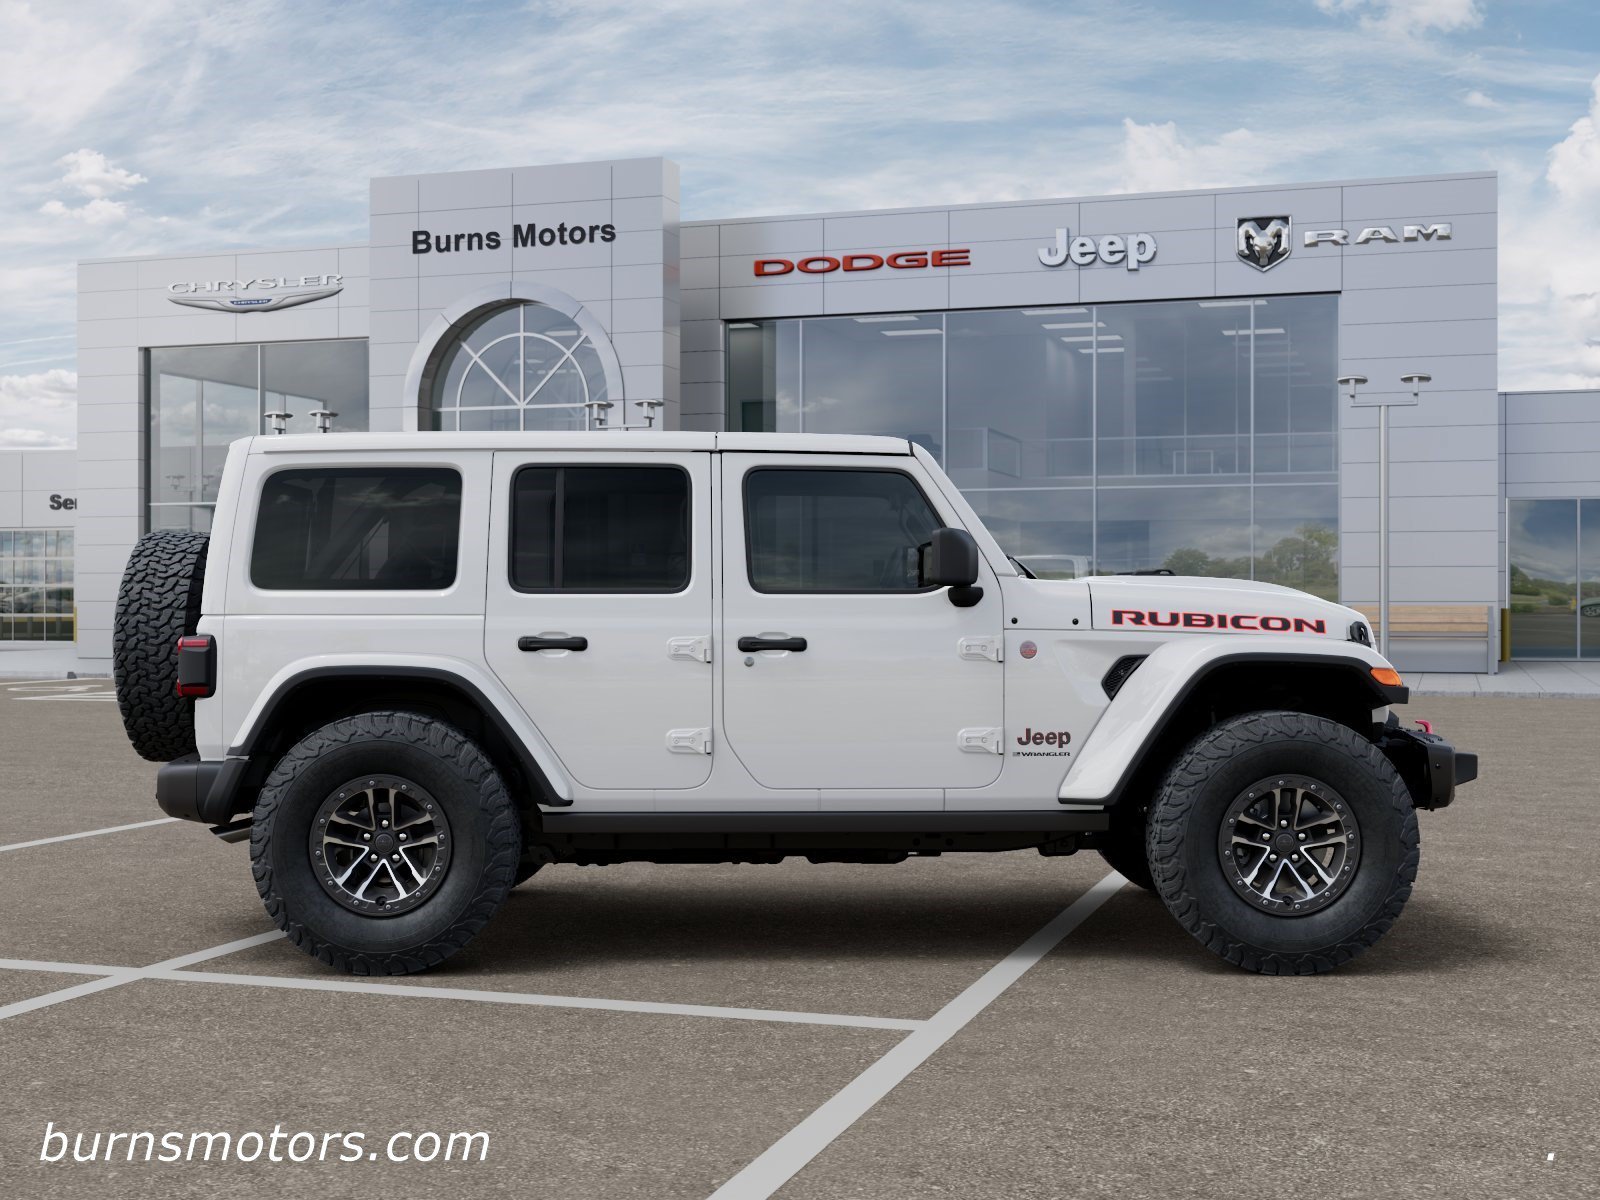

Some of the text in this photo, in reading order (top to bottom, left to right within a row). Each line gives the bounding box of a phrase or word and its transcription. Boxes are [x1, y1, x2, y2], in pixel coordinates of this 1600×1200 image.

[412, 223, 616, 254] Burns Motors
[1304, 223, 1452, 247] RAM
[1038, 227, 1157, 271] Jeep
[753, 249, 972, 276] DODGE
[167, 273, 343, 293] CHRYSLER
[49, 494, 77, 510] Se
[1111, 609, 1327, 634] RUBICON
[1017, 728, 1071, 748] Jeep
